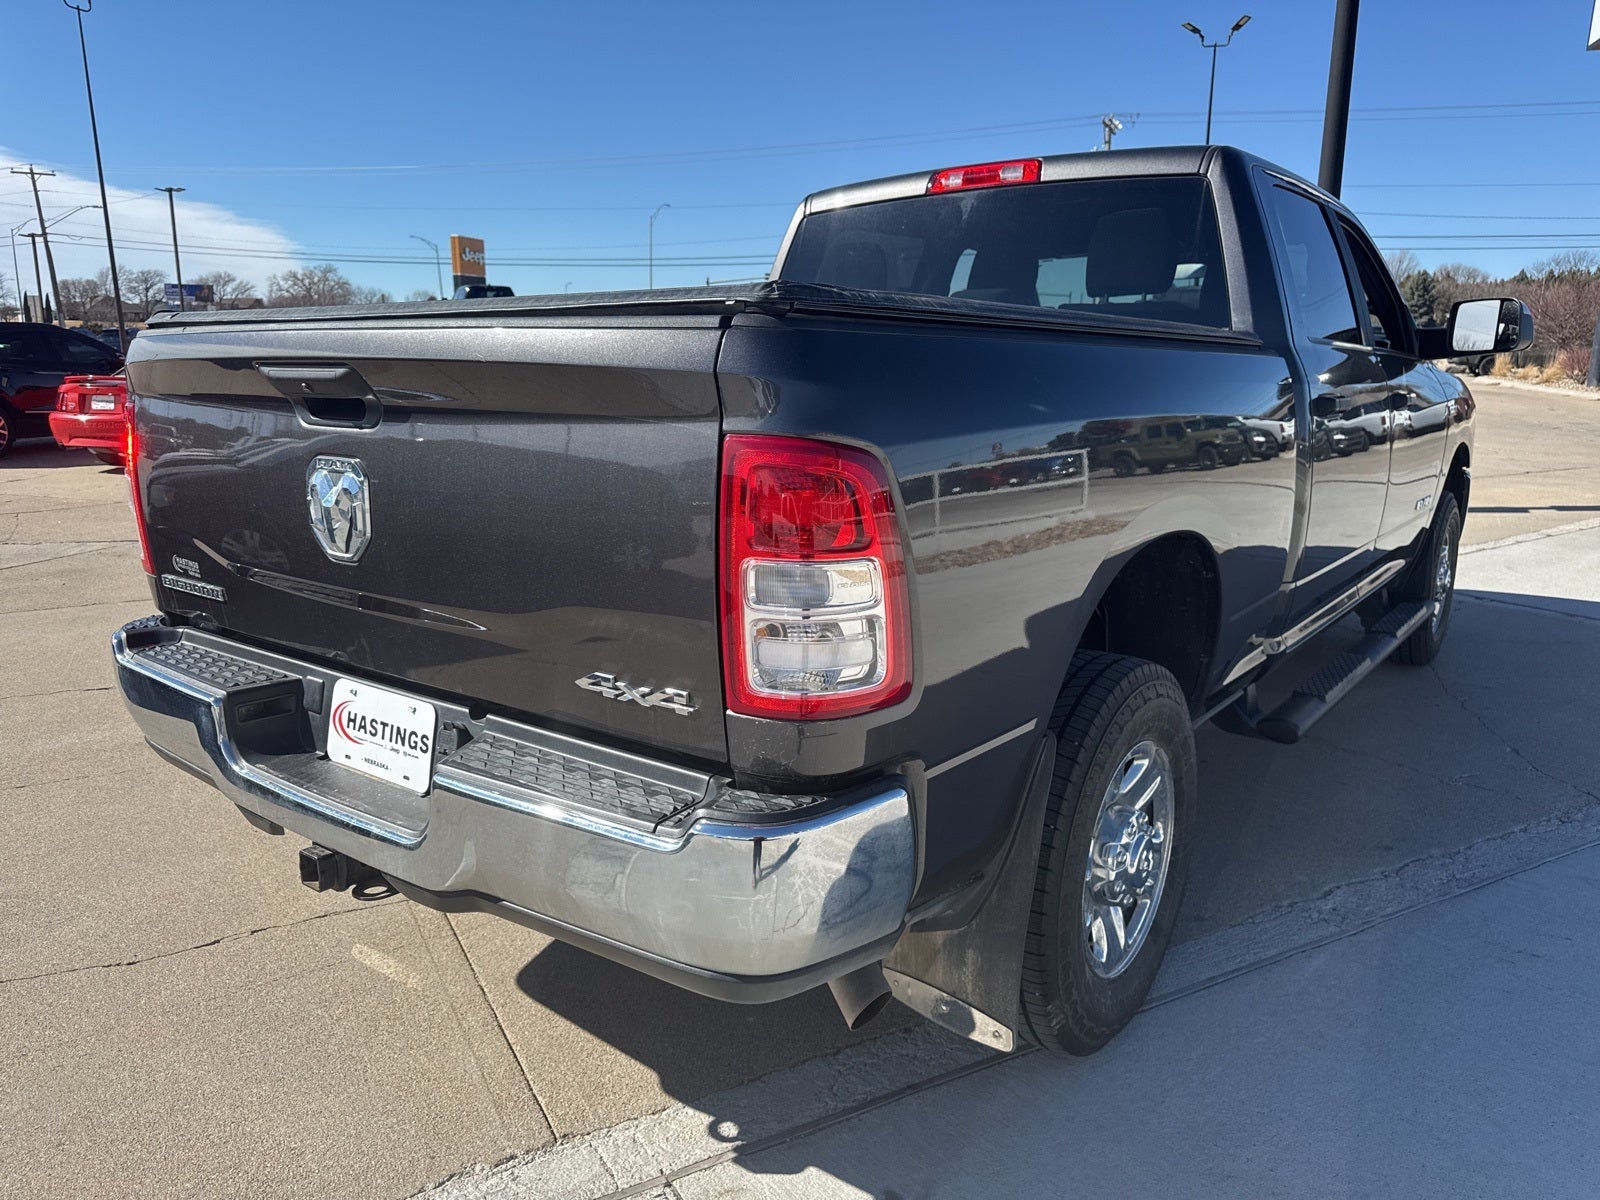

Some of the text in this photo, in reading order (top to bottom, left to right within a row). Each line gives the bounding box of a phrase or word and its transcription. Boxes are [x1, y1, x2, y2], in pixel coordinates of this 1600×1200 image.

[316, 459, 353, 471] RAM
[346, 711, 430, 754] HASTINGS
[363, 757, 389, 771] NEBRASKA
